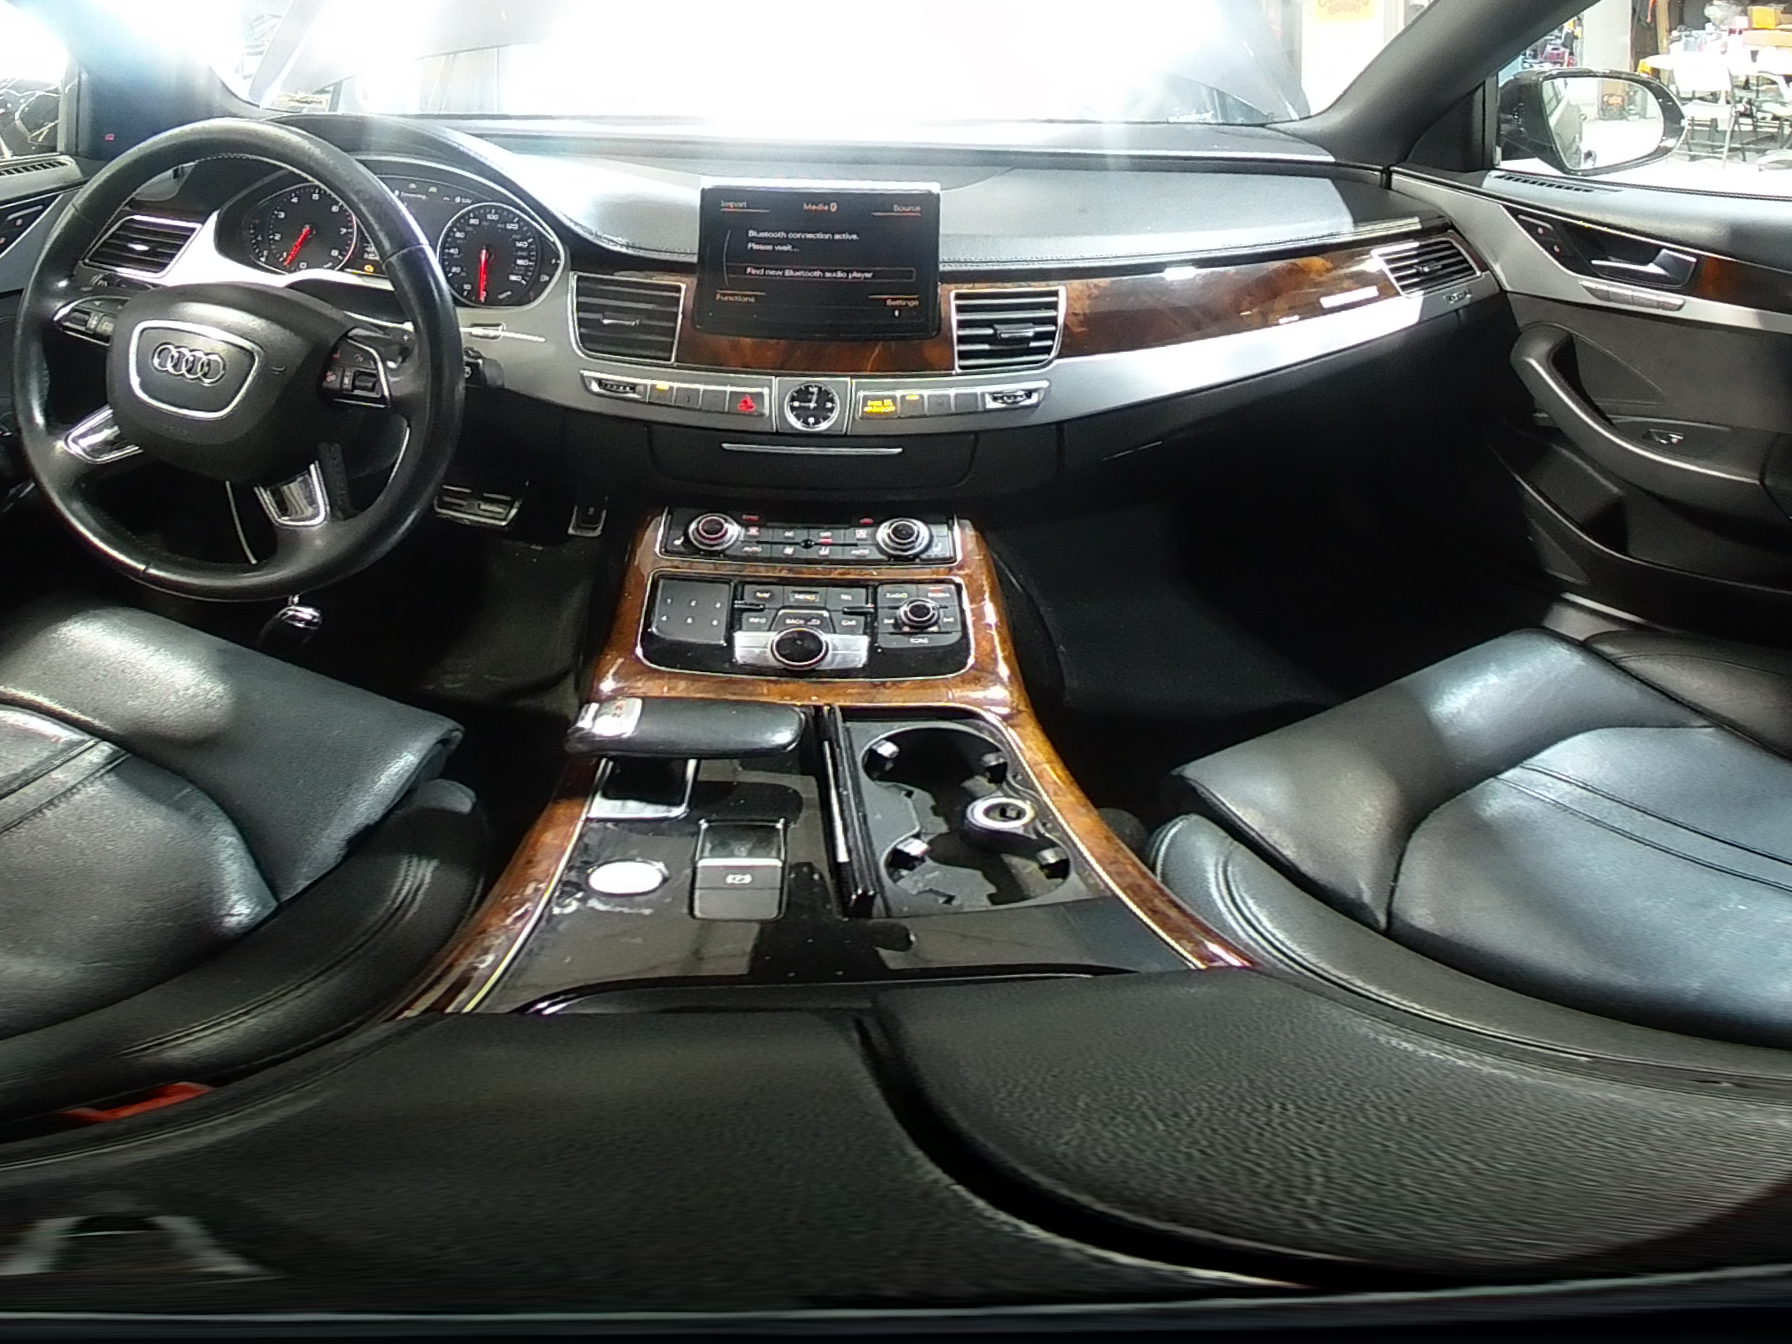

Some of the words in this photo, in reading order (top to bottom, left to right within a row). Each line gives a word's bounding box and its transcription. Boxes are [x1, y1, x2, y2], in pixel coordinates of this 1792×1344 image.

[721, 200, 747, 209] Import
[803, 203, 828, 211] Media
[893, 204, 921, 212] Source
[748, 230, 786, 239] Bluetooth
[788, 231, 832, 240] connection
[747, 242, 773, 251] Please
[746, 267, 764, 275] Find
[784, 269, 823, 278] Bluetooth
[824, 270, 847, 278] audio
[848, 270, 873, 280] player
[715, 294, 755, 303] Functions
[886, 298, 920, 307] Settings
